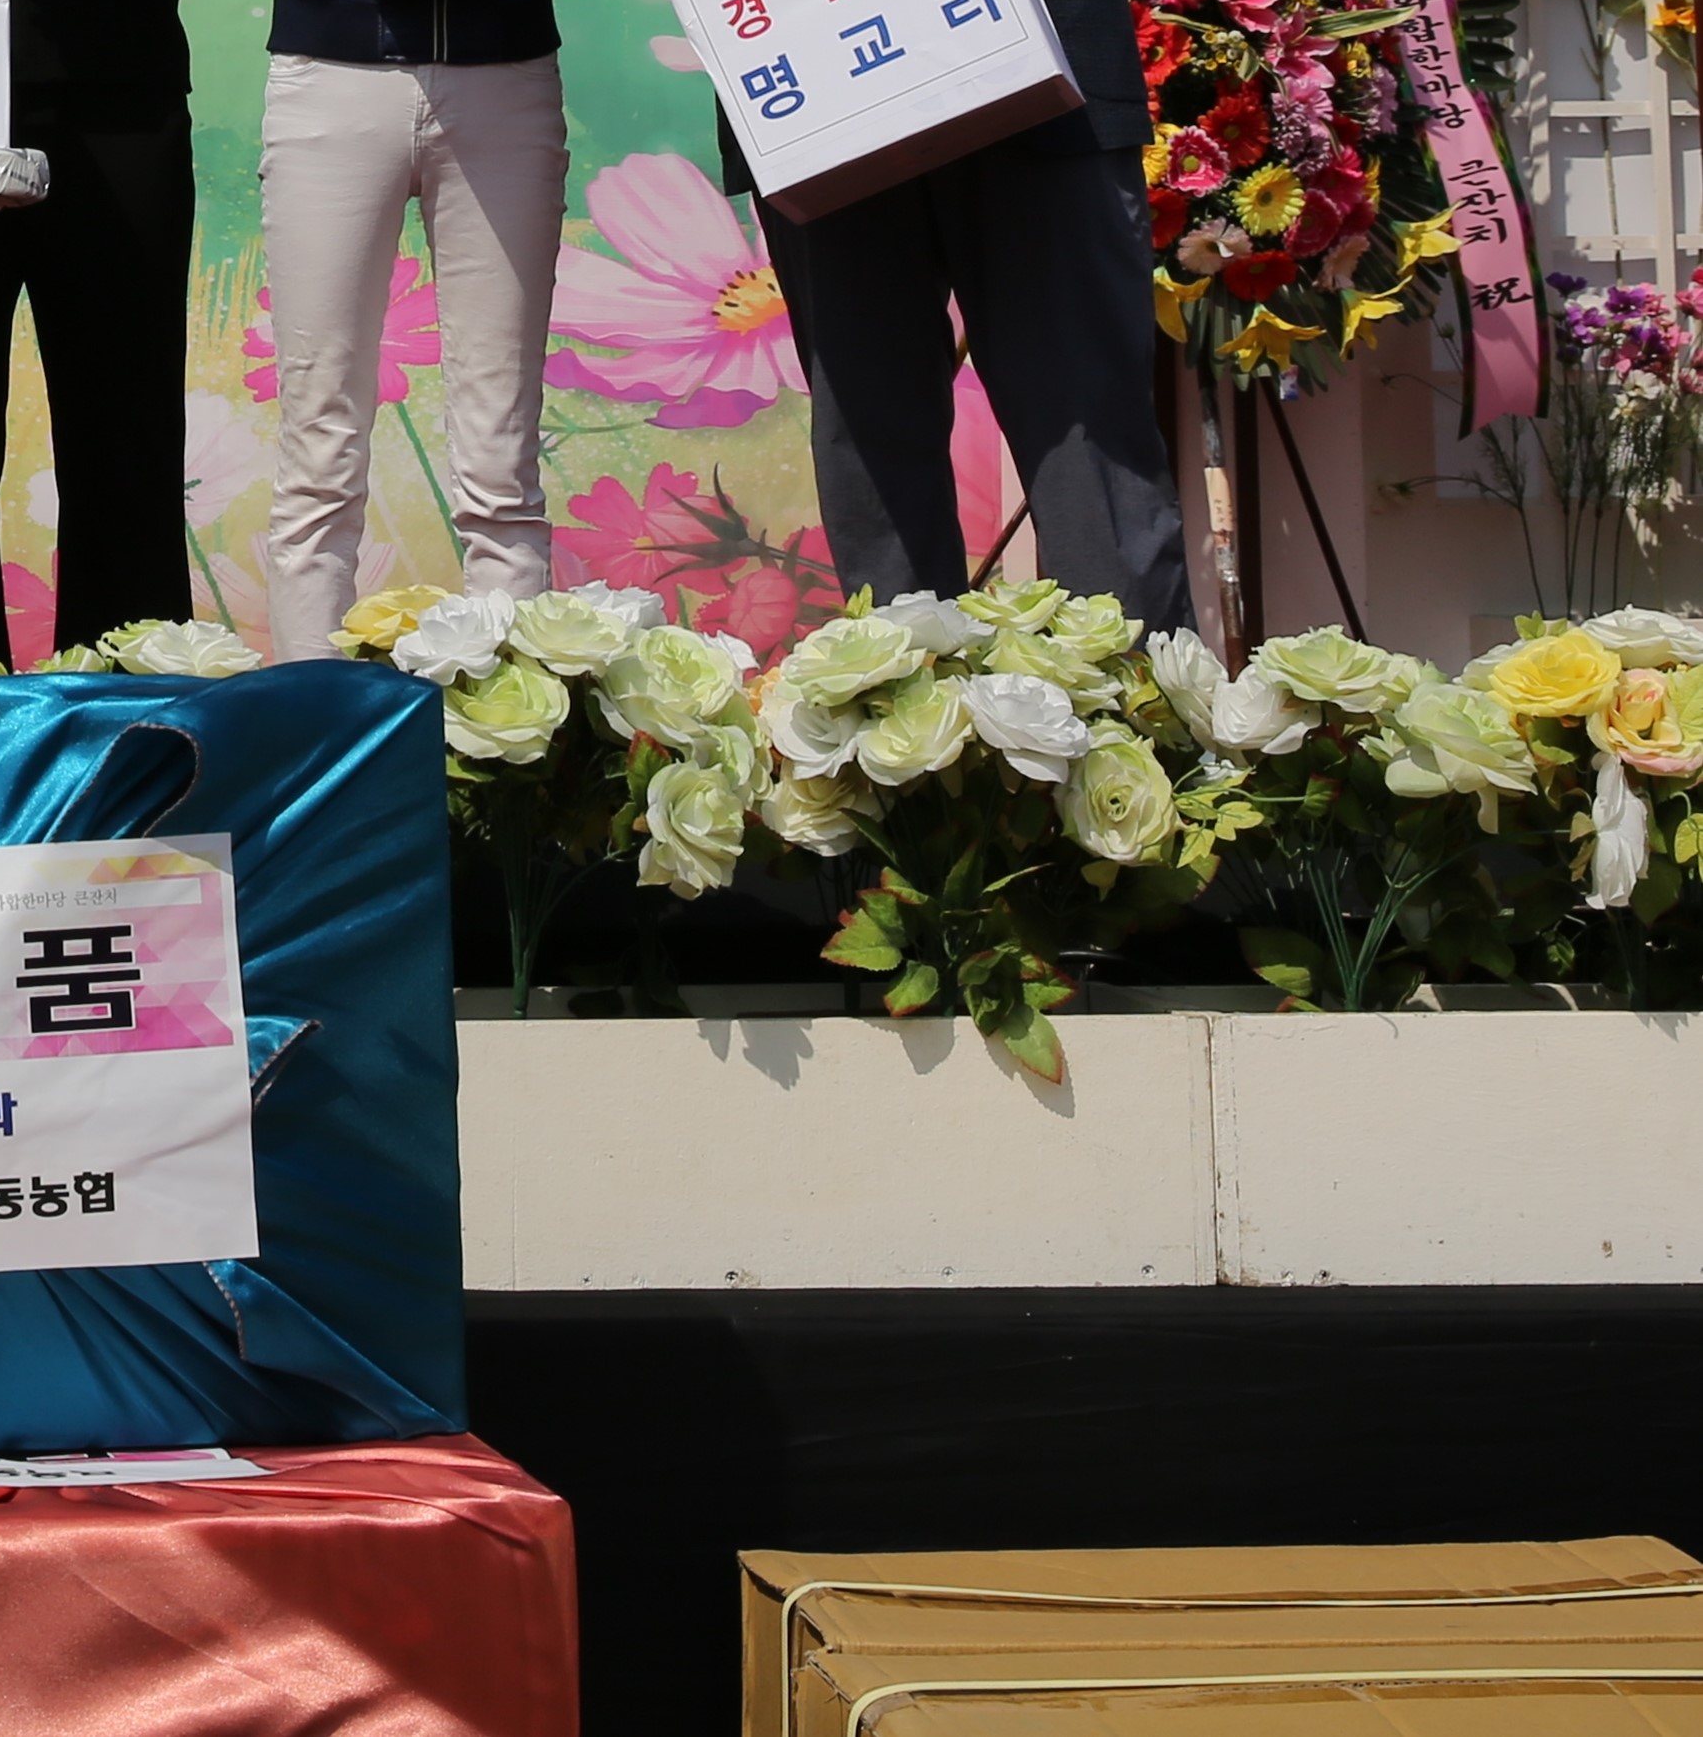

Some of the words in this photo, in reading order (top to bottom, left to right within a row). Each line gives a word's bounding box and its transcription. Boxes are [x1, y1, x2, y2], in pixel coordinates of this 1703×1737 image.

[1448, 160, 1507, 243] 큰잔치
[1471, 278, 1533, 310] 祝
[74, 888, 118, 906] 큰잔치
